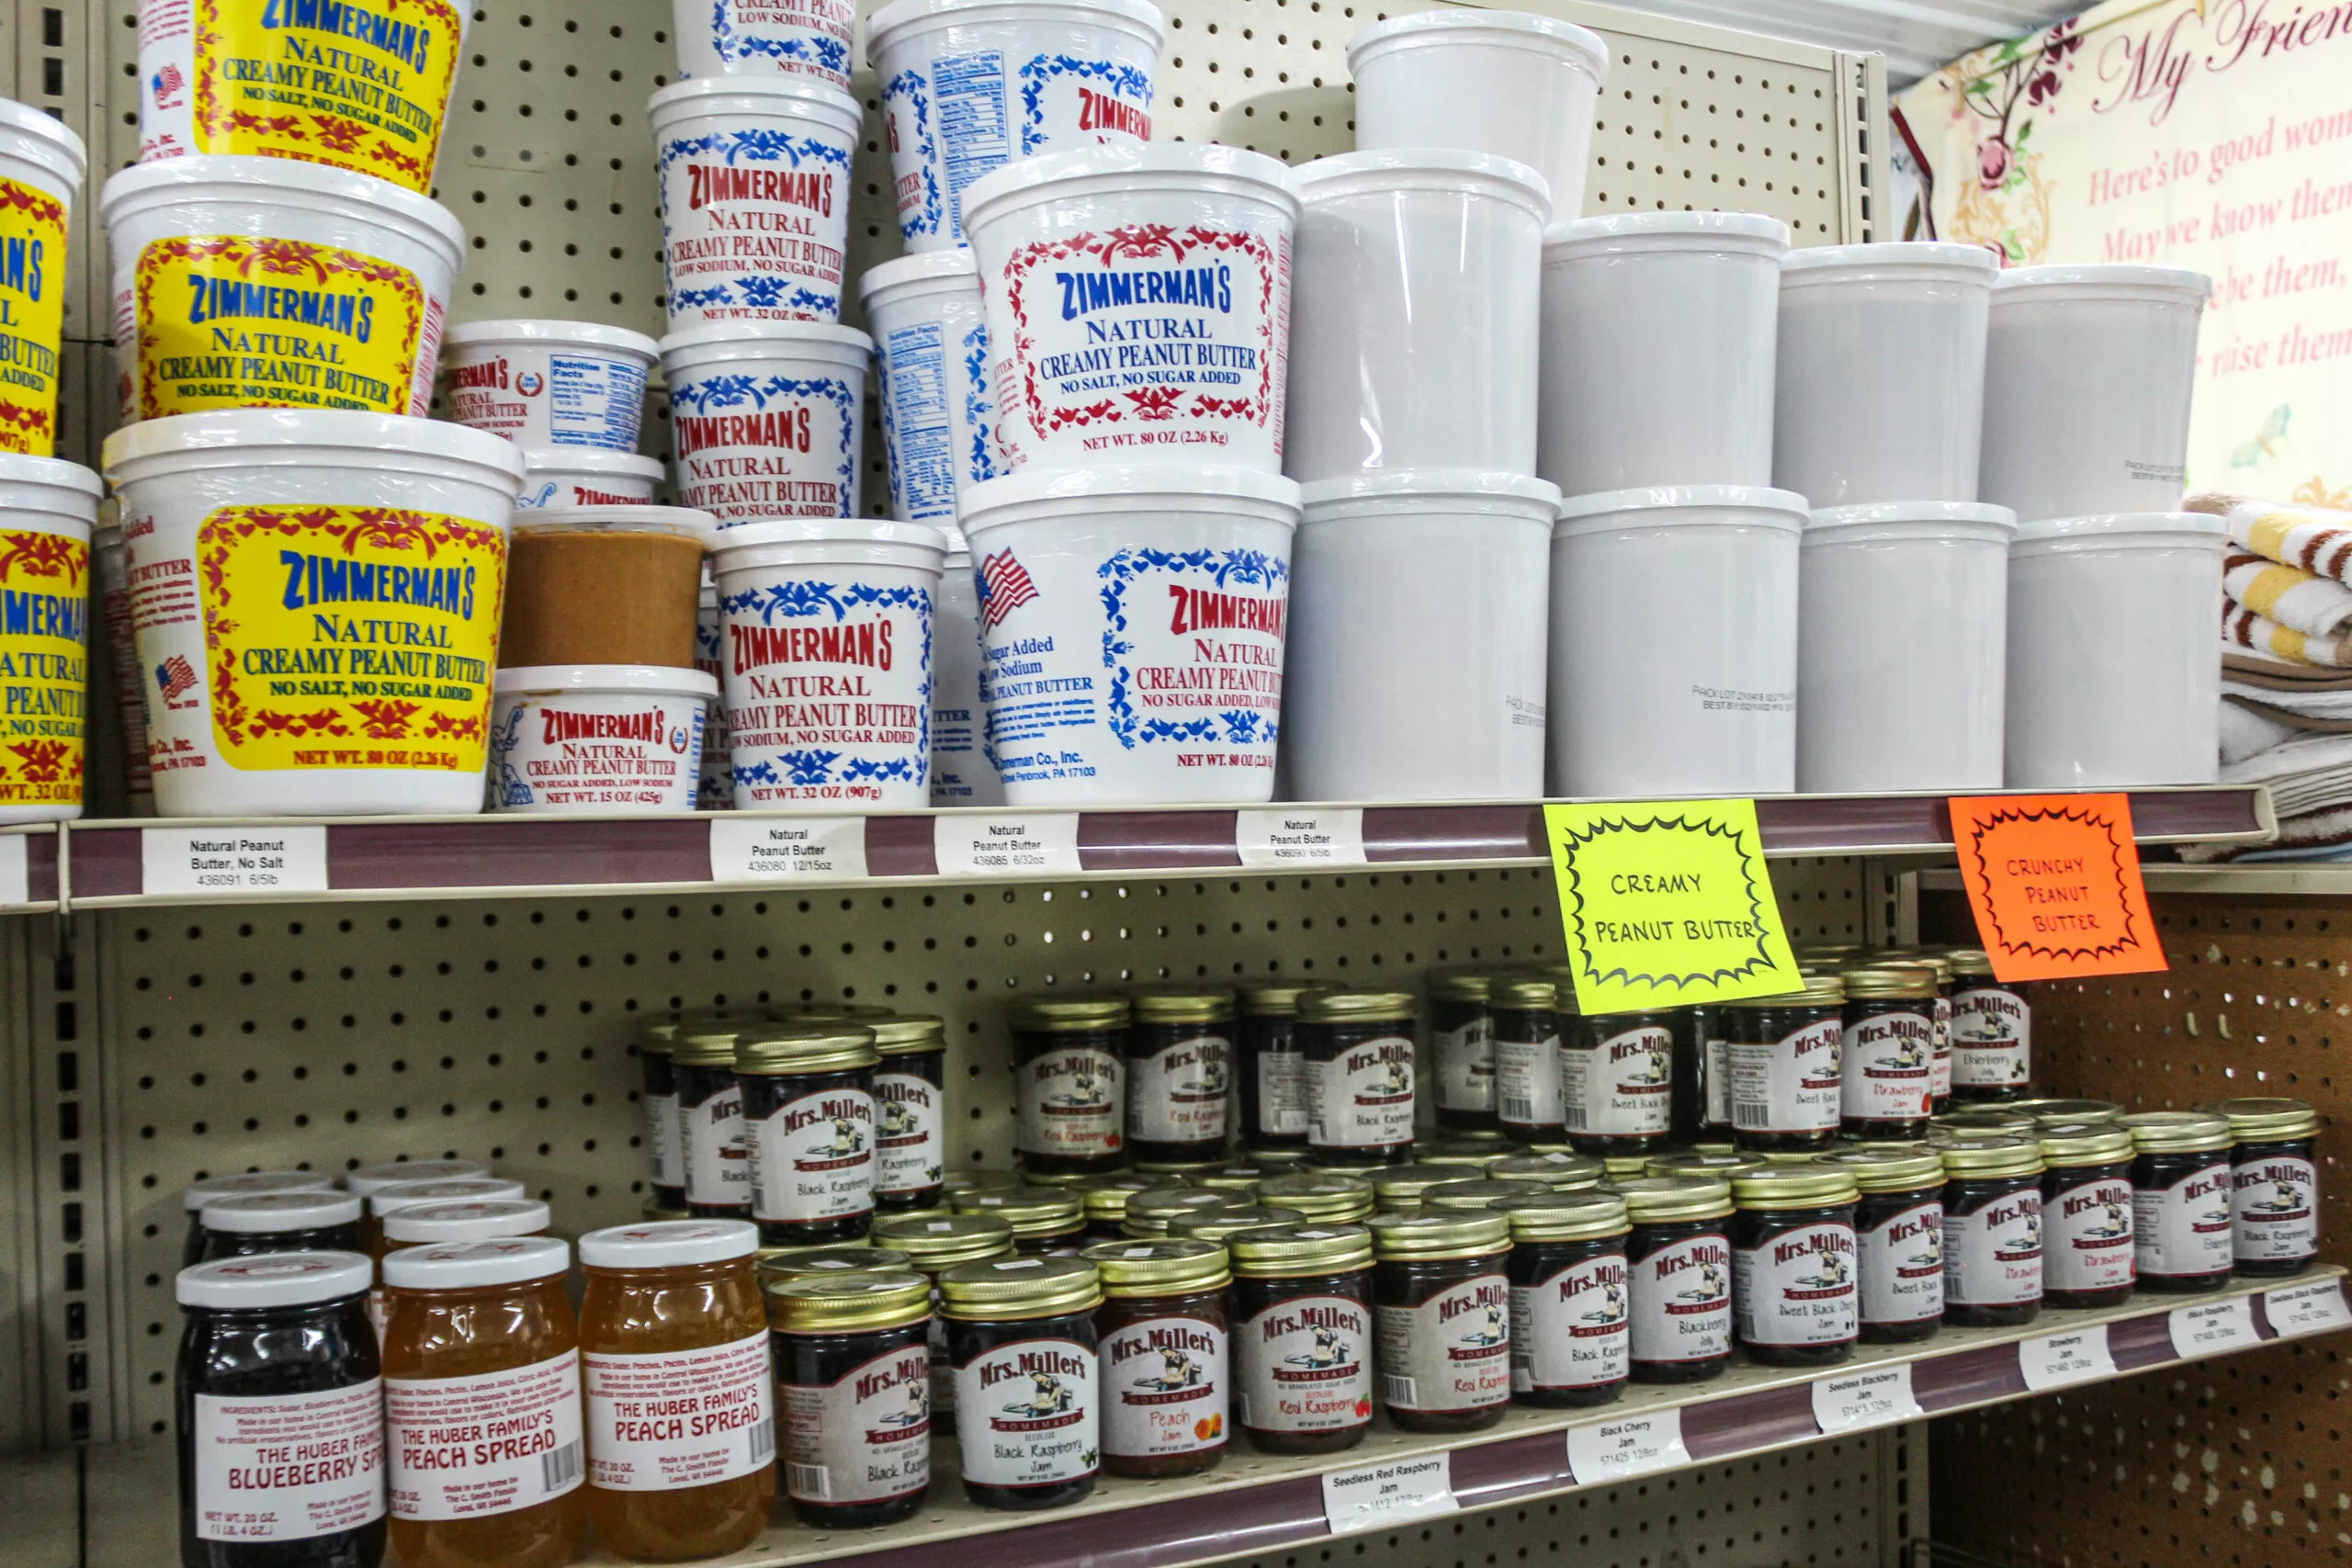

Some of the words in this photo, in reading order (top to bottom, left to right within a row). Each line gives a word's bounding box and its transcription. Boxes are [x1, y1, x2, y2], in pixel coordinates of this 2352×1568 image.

[738, 12, 768, 24] LOW
[261, 0, 431, 74] ZIMMERMAN'S
[284, 36, 403, 93] NATURAL
[2091, 8, 2205, 126] My
[222, 58, 308, 85] CREAMY
[312, 72, 386, 110] PEANUT
[386, 93, 433, 137] BUTTER
[2087, 151, 2168, 208] Here's
[2171, 149, 2200, 179] to
[2207, 116, 2277, 186] good
[687, 164, 832, 219] ZIMMERMAN'S
[707, 209, 816, 236] NATURAL
[2209, 197, 2284, 242] know
[672, 236, 728, 264] CREAMY
[732, 236, 799, 261] PEANUT
[802, 240, 842, 272] BUTTER
[752, 259, 773, 271] NO
[775, 261, 814, 276] SUGAR
[1056, 258, 1231, 321] ZIMMERMAN'S
[188, 274, 374, 344] ZIMMERMAN'S
[1085, 319, 1213, 344] NATURAL
[211, 327, 345, 366] NATURAL
[553, 360, 600, 372] Nutrition
[1040, 347, 1114, 380] CREAMY
[1118, 344, 1193, 369] PEANUT
[1197, 344, 1256, 370] BUTTER
[159, 356, 238, 382] CREAMY
[241, 358, 320, 392] PEANUT
[323, 371, 390, 405] BUTTER
[1060, 380, 1080, 395] NO
[1123, 371, 1144, 386] NO
[1147, 370, 1195, 384] SUGAR
[1199, 371, 1241, 385] ADDED
[266, 387, 321, 406] SUGAR
[675, 401, 810, 461] ZIMMERMAN'S
[1082, 436, 1109, 452] NET
[1157, 432, 1178, 445] OZ
[688, 456, 791, 481] NATURAL
[709, 480, 772, 504] PEANUT
[776, 481, 837, 504] BUTTER
[796, 505, 835, 517] ADDED
[279, 549, 476, 622] ZIMMERMAN'S
[312, 614, 453, 649] NATURAL
[730, 613, 893, 676] ZIMMERMAN'S
[1012, 637, 1055, 657] Added
[1193, 638, 1278, 668] NATURAL
[243, 649, 344, 675] CREAMY
[350, 649, 433, 679] PEANUT
[435, 653, 486, 684] BUTTER
[1001, 660, 1044, 679] Sodium
[269, 682, 299, 696] NO
[352, 682, 378, 696] NO
[379, 682, 432, 698] SUGAR
[749, 675, 872, 700] NATURAL
[1036, 677, 1095, 694] BUTTER
[1136, 667, 1216, 691] CREAMY
[1219, 668, 1268, 693] PEANUT
[1142, 694, 1163, 707] NO
[1166, 694, 1213, 707] SUGAR
[540, 705, 664, 746] ZIMMERMAN'S
[775, 704, 851, 728] PEANUT
[855, 704, 917, 728] BUTTER
[797, 730, 819, 744] NO
[822, 730, 873, 743] SUGAR
[876, 730, 916, 744] ADDED
[562, 743, 647, 760] NATURAL
[1177, 754, 1204, 768] NET
[526, 761, 580, 776] CREAMY
[583, 761, 634, 775] PEANUT
[636, 761, 676, 775] BUTTER
[751, 788, 772, 801] NET
[820, 786, 842, 799] OZ
[845, 786, 882, 801] (907g)
[769, 829, 808, 840] Natural
[989, 825, 1025, 837] Natural
[1284, 819, 1317, 831] Natural
[190, 840, 237, 853] Natural
[240, 840, 285, 853] Peanut
[973, 840, 1009, 852] Peanut
[1011, 840, 1042, 852] Butter
[1270, 834, 1301, 847] Peanut
[1302, 833, 1331, 845] Butter
[752, 845, 790, 857] Peanut
[792, 844, 826, 856] Butter
[972, 854, 1009, 866] 436085
[1012, 854, 1046, 866] 6/32oz
[191, 857, 234, 872] Butter,
[238, 858, 256, 871] No
[258, 857, 284, 870] Salt
[748, 860, 786, 872] 436080
[792, 860, 832, 872] 12/15oz
[2007, 857, 2085, 876] CRUNCHY
[197, 874, 242, 887] 436091
[1611, 874, 1702, 896] CREAMY
[2025, 886, 2089, 905] PEANUT
[1594, 920, 1674, 943] PEANUT
[1683, 919, 1756, 941] BUTTER
[2032, 914, 2100, 932] BUTTER
[1872, 1082, 1925, 1098] Strawberry
[797, 1183, 826, 1197] Black
[1779, 1303, 1809, 1317] Sweet
[1812, 1303, 1836, 1316] Black
[1679, 1318, 1726, 1336] Blackberry
[1572, 1348, 1599, 1362] Black
[1280, 1368, 1354, 1382] HOMEMADE
[1827, 1378, 1861, 1394] Seedless
[1861, 1371, 1900, 1388] Blackberry
[614, 1402, 641, 1418] THE
[646, 1397, 699, 1416] HUBER
[704, 1383, 759, 1411] FAMILY'S
[1130, 1388, 1206, 1404] HOMEMADE
[1306, 1396, 1357, 1416] Raspberry
[401, 1429, 425, 1446] THE
[429, 1425, 482, 1444] HUBER
[487, 1409, 553, 1439] FAMILY'S
[615, 1419, 684, 1442] PEACH
[691, 1402, 760, 1438] SPREAD
[999, 1416, 1078, 1431] HOMEMADE
[1150, 1409, 1191, 1427] Peach
[1160, 1429, 1183, 1442] Jam
[1600, 1426, 1623, 1438] Black
[1624, 1420, 1652, 1435] Cherry
[256, 1447, 291, 1464] THE
[297, 1438, 350, 1461] HUBER
[402, 1447, 467, 1471] PEACH
[474, 1428, 557, 1465] SPREAD
[993, 1444, 1024, 1459] Black
[1030, 1438, 1083, 1461] Raspberry
[1618, 1437, 1636, 1449] Jam
[230, 1455, 357, 1490] BLUEBERRY
[867, 1462, 899, 1482] Black
[1030, 1461, 1054, 1473] Jam
[1332, 1474, 1374, 1489] Seedless
[1376, 1470, 1394, 1482] Red
[1396, 1459, 1442, 1477] Raspberry
[1379, 1483, 1399, 1495] Jam
